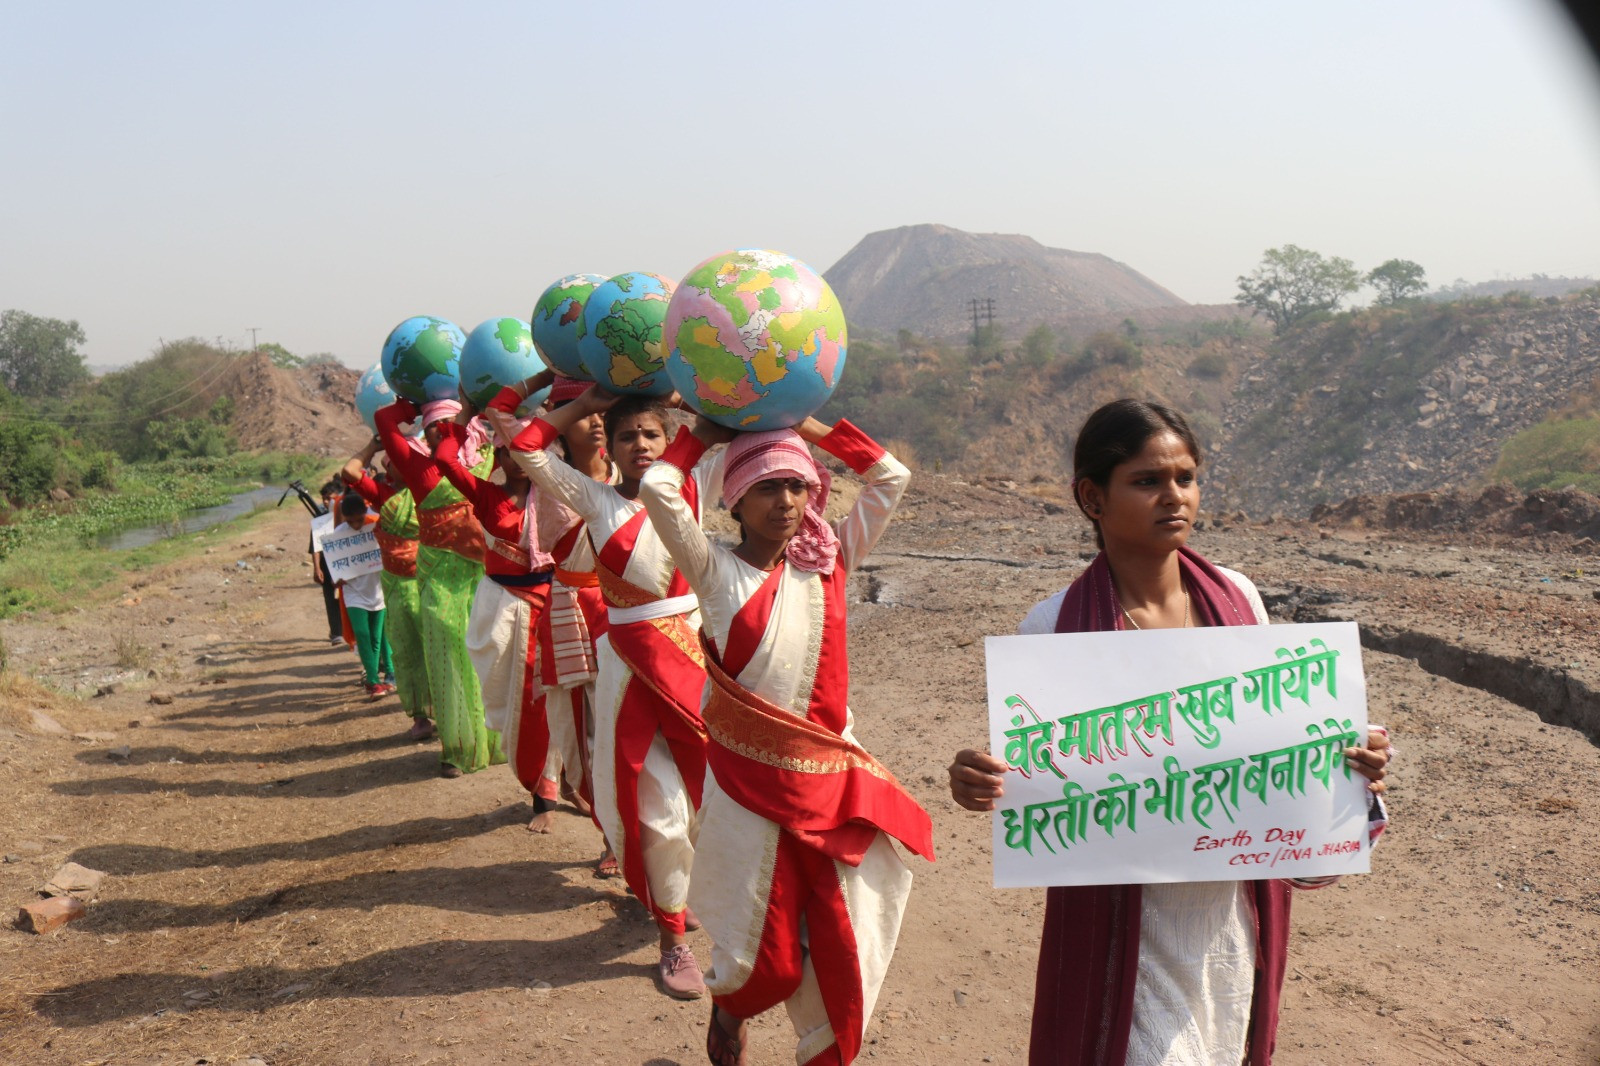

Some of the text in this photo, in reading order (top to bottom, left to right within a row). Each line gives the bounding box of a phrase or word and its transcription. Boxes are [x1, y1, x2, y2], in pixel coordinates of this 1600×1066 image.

[1058, 691, 1176, 765] मातरम
[1001, 782, 1095, 857] धरती
[1094, 773, 1141, 838] को
[1143, 756, 1190, 824] भी
[1191, 758, 1246, 830] हरा
[1194, 828, 1306, 851] Earth Day
